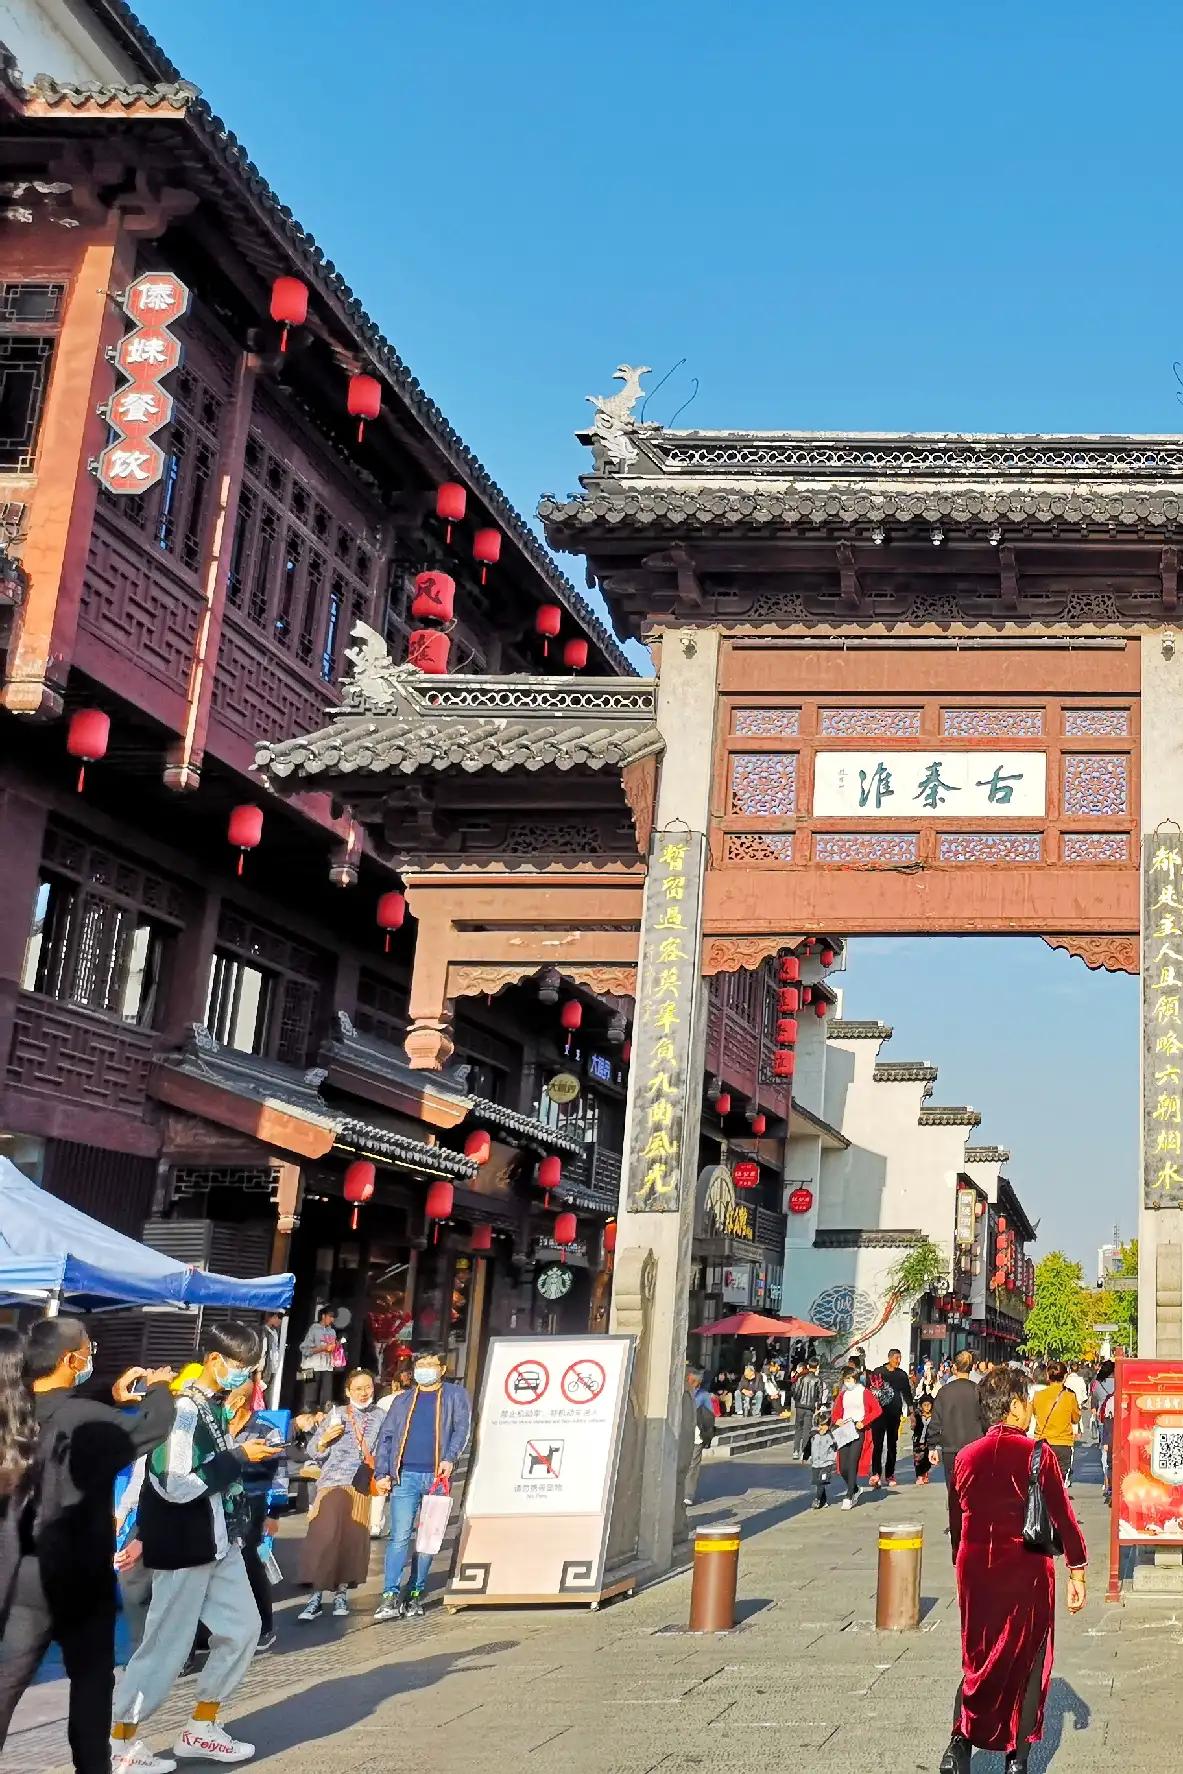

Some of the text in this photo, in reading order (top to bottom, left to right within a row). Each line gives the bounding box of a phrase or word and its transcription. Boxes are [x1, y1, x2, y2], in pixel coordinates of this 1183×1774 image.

[110, 283, 177, 480] 傣妹餐饮
[858, 761, 1024, 810] 古秦淮
